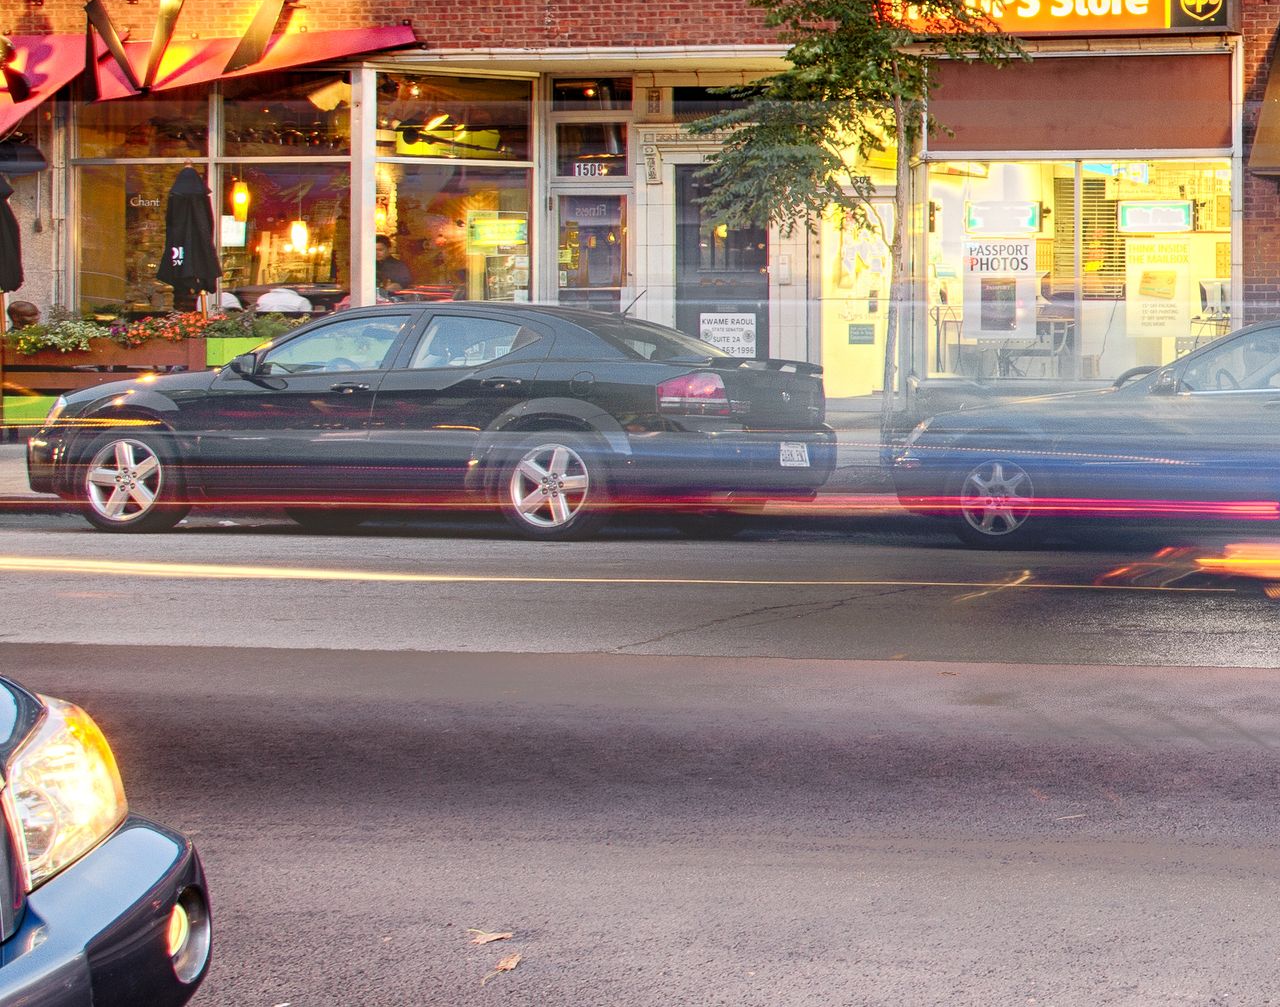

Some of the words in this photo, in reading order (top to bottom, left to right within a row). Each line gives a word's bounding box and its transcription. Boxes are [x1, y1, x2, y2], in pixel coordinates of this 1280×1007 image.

[575, 163, 605, 176] 1509
[130, 194, 160, 207] Chant
[969, 244, 1030, 256] PASSPORT
[1128, 244, 1155, 253] THINK
[1158, 244, 1187, 253] INSIDE
[970, 257, 1029, 271] PHOTOS
[1128, 255, 1143, 264] THE
[1147, 255, 1189, 264] MAILBOX
